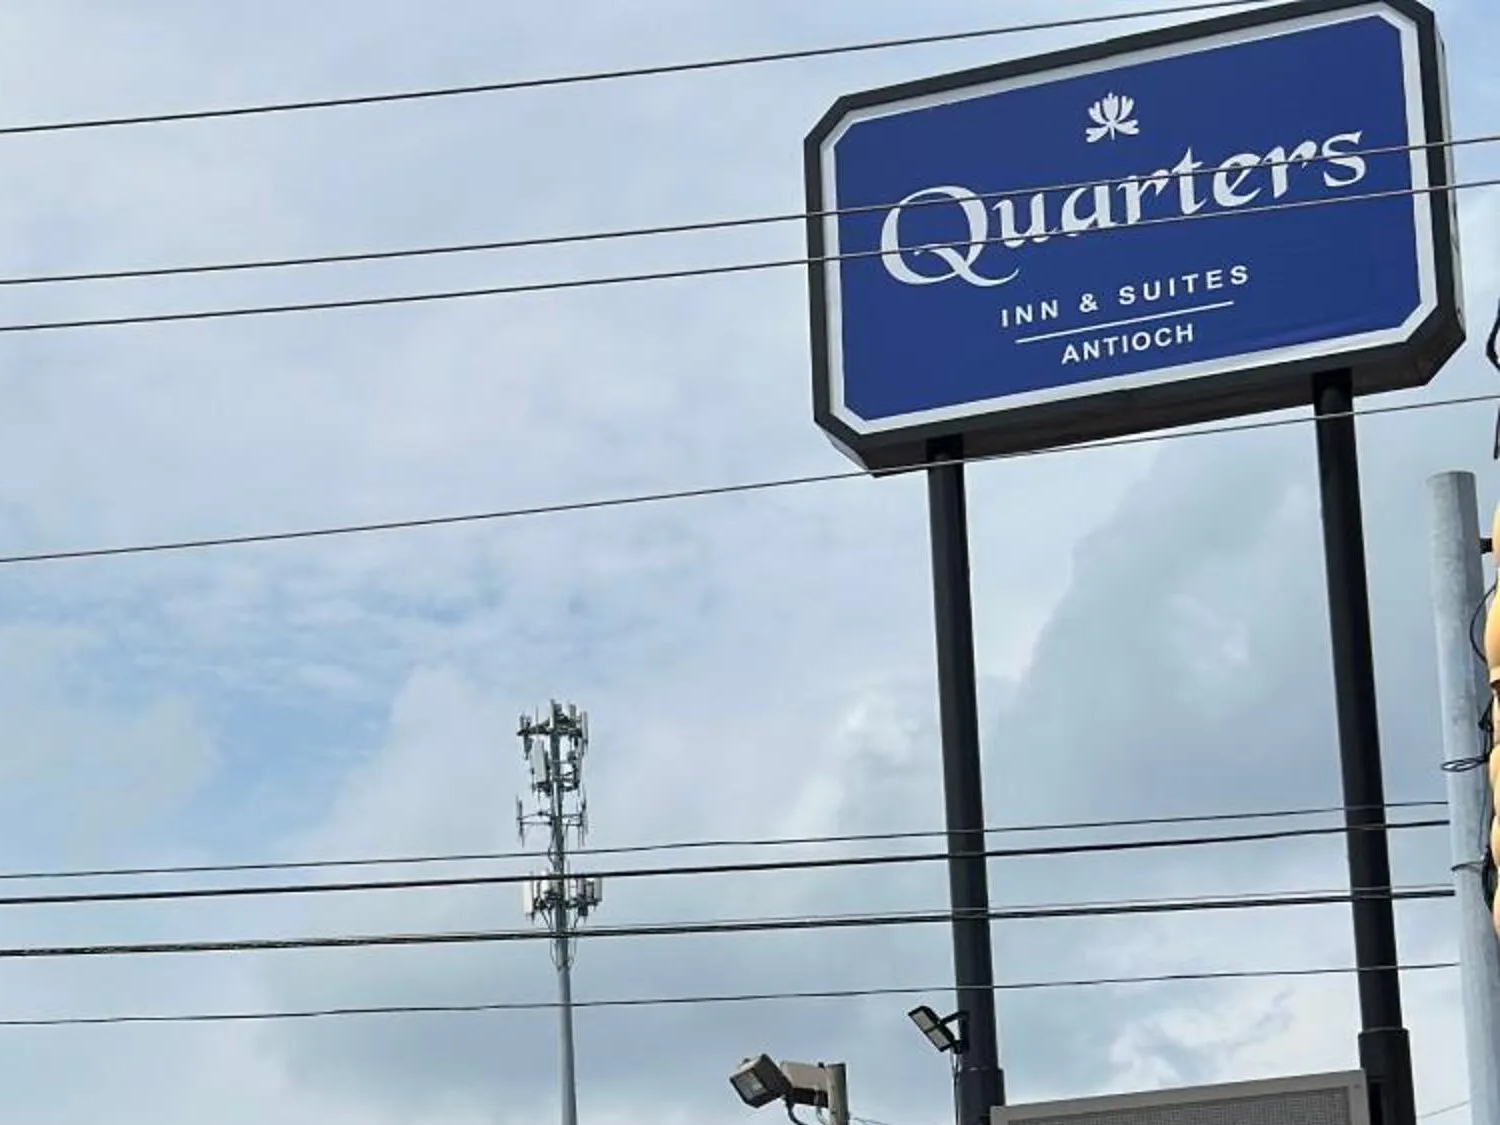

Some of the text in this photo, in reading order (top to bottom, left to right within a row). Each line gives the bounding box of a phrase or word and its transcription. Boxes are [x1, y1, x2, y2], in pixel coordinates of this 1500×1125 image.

[880, 130, 1367, 287] Quarters
[1001, 265, 1248, 328] INN & SUITES
[1061, 323, 1194, 365] ANTIOCH
